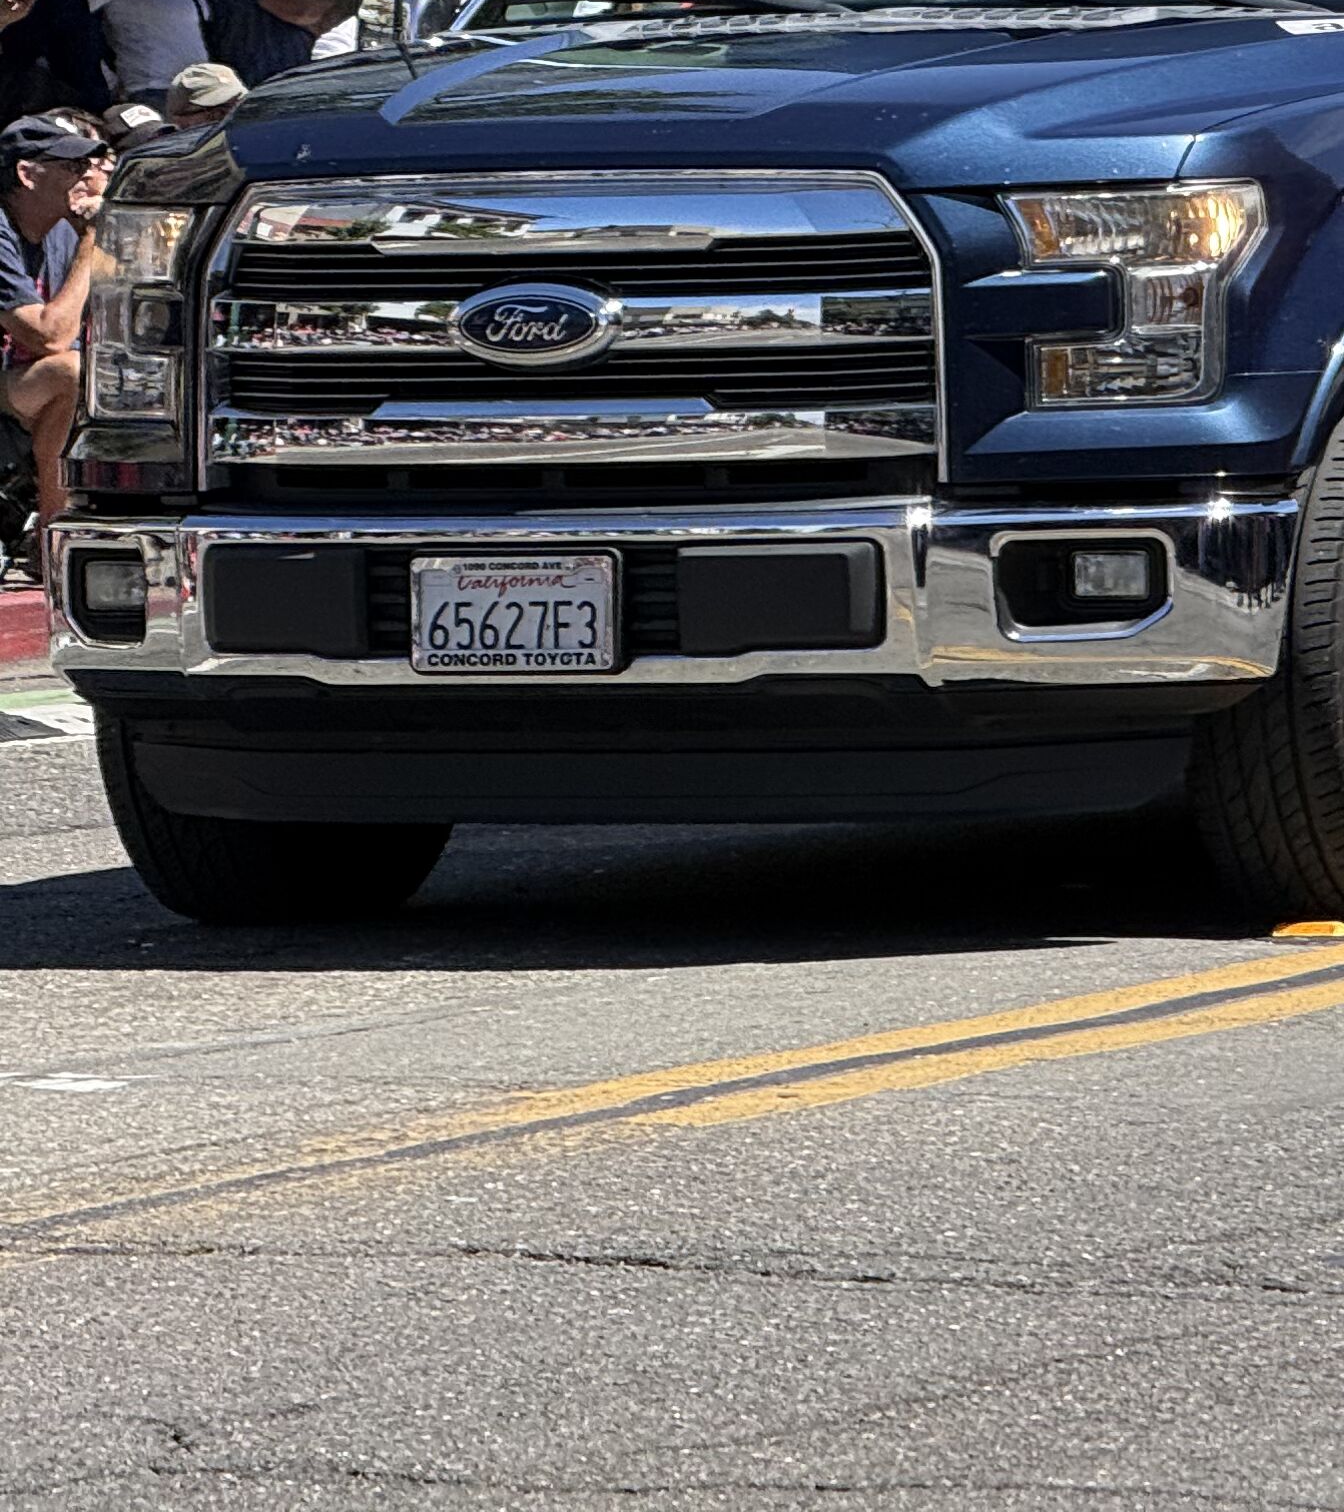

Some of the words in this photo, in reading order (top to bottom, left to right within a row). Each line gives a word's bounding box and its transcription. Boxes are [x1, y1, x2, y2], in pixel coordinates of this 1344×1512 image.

[485, 303, 568, 342] Ford
[457, 574, 577, 598] California
[428, 600, 597, 650] 65627F3
[428, 653, 516, 666] CONCORD
[525, 653, 596, 666] TOYOTA
